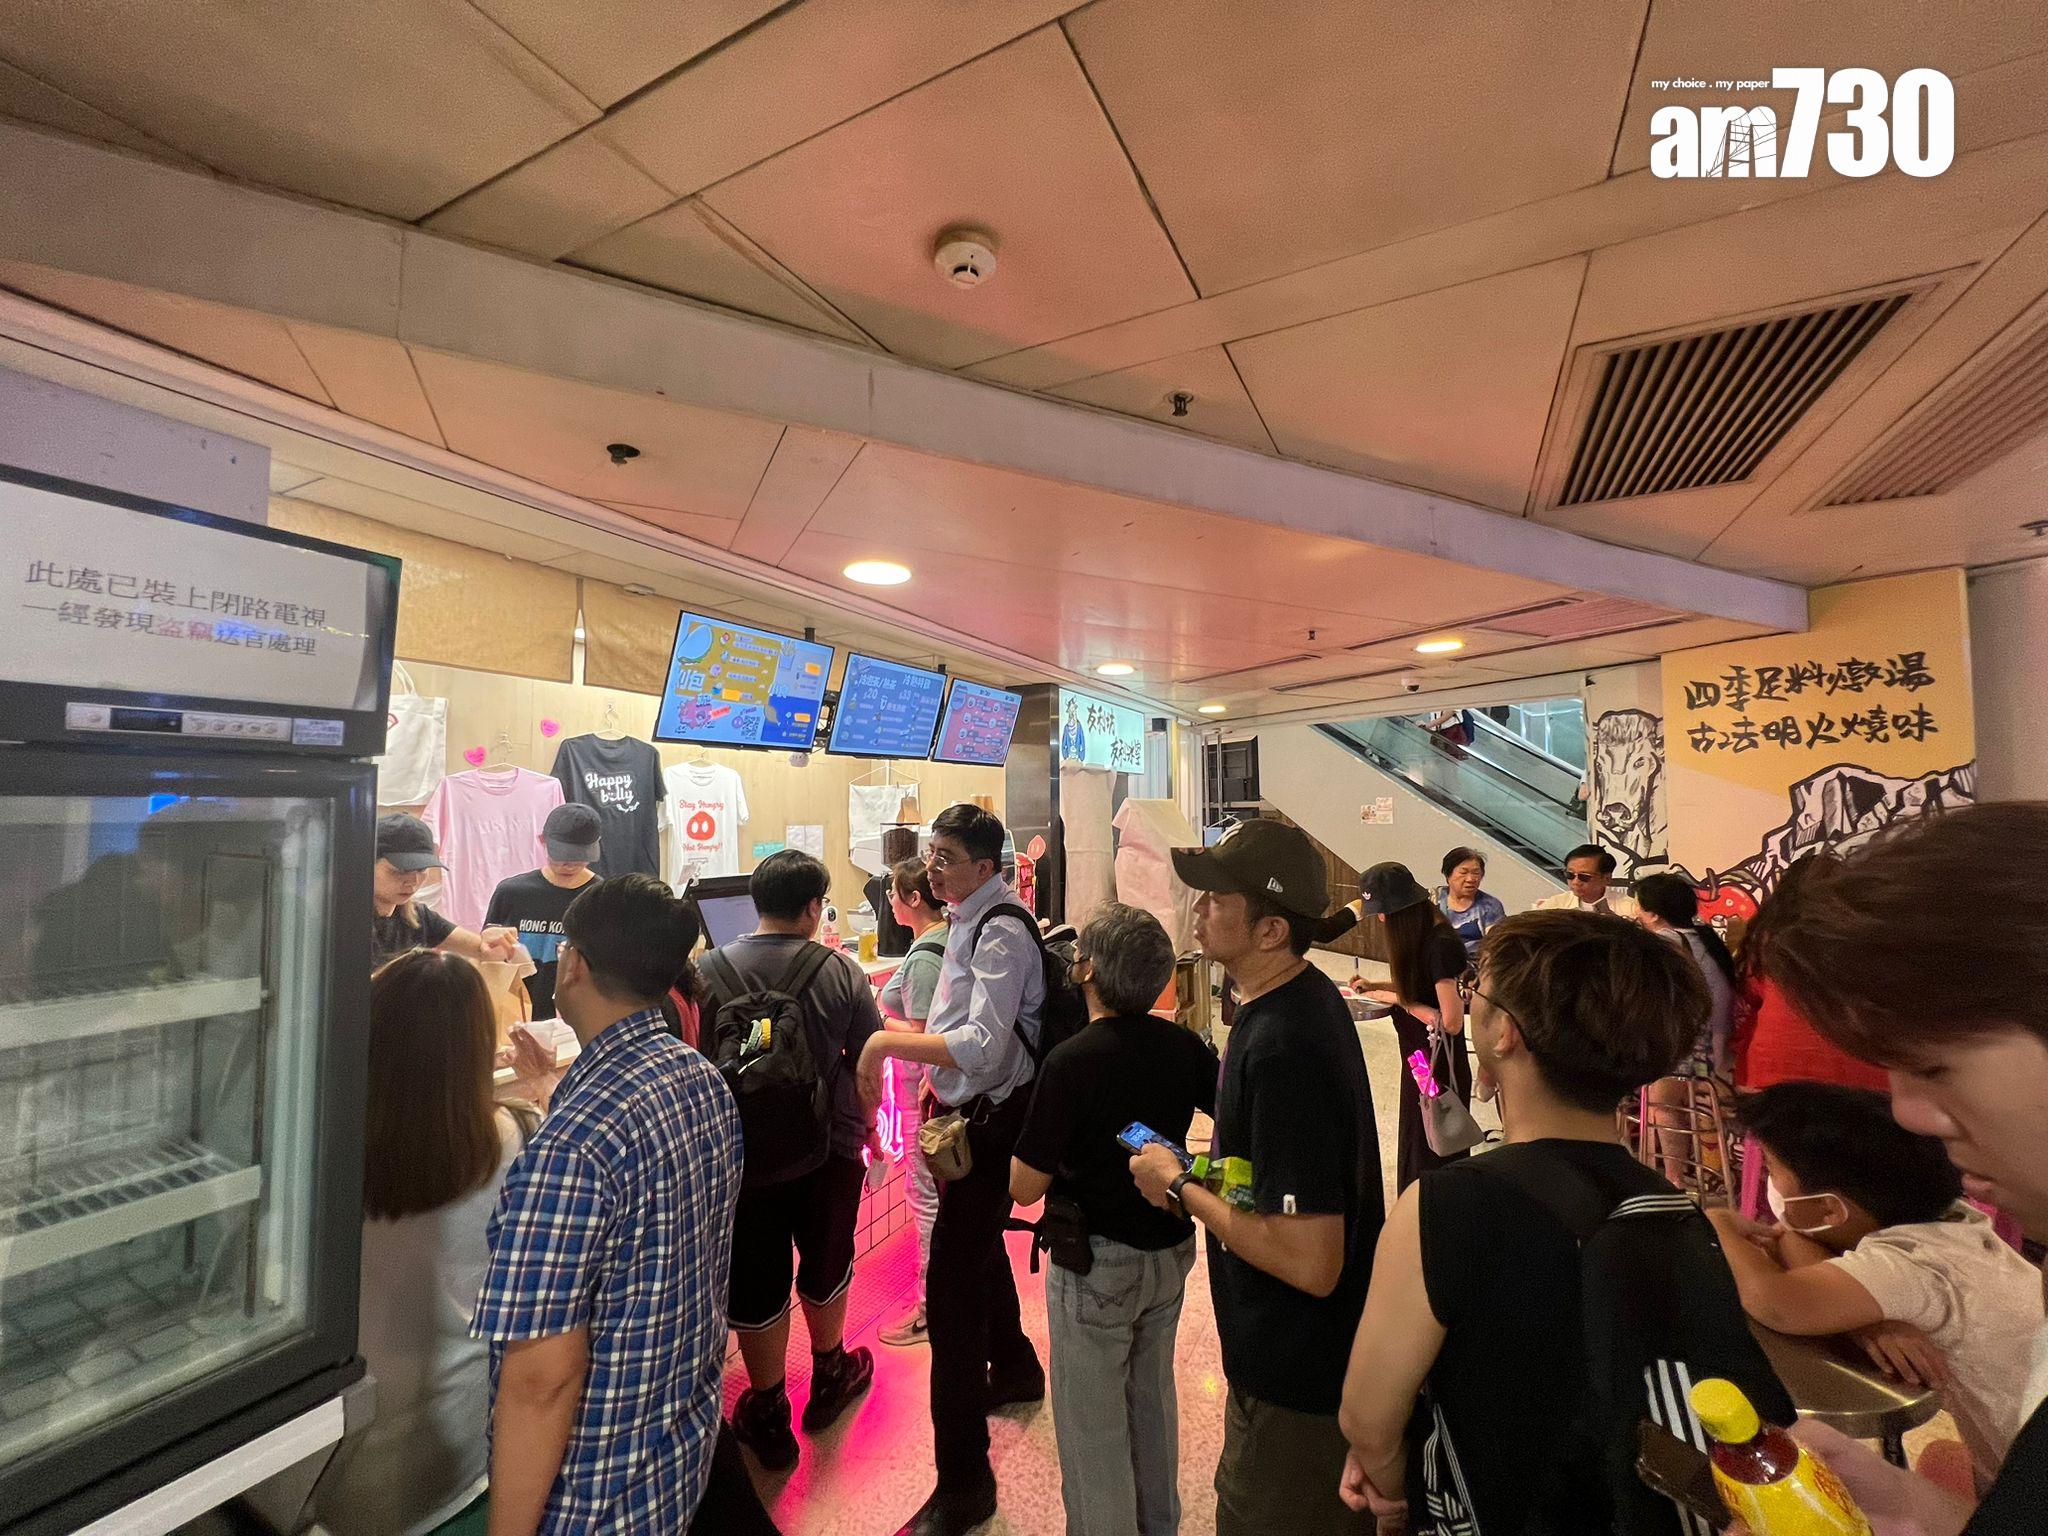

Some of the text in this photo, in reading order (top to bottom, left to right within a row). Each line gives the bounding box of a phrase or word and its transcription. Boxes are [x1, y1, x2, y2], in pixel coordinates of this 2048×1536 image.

[25, 560, 326, 629] 此處已裝上閉路電視
[1686, 703, 1939, 754] 古法明火燒味
[585, 773, 632, 790] Happy
[519, 919, 565, 934] HONG KO
